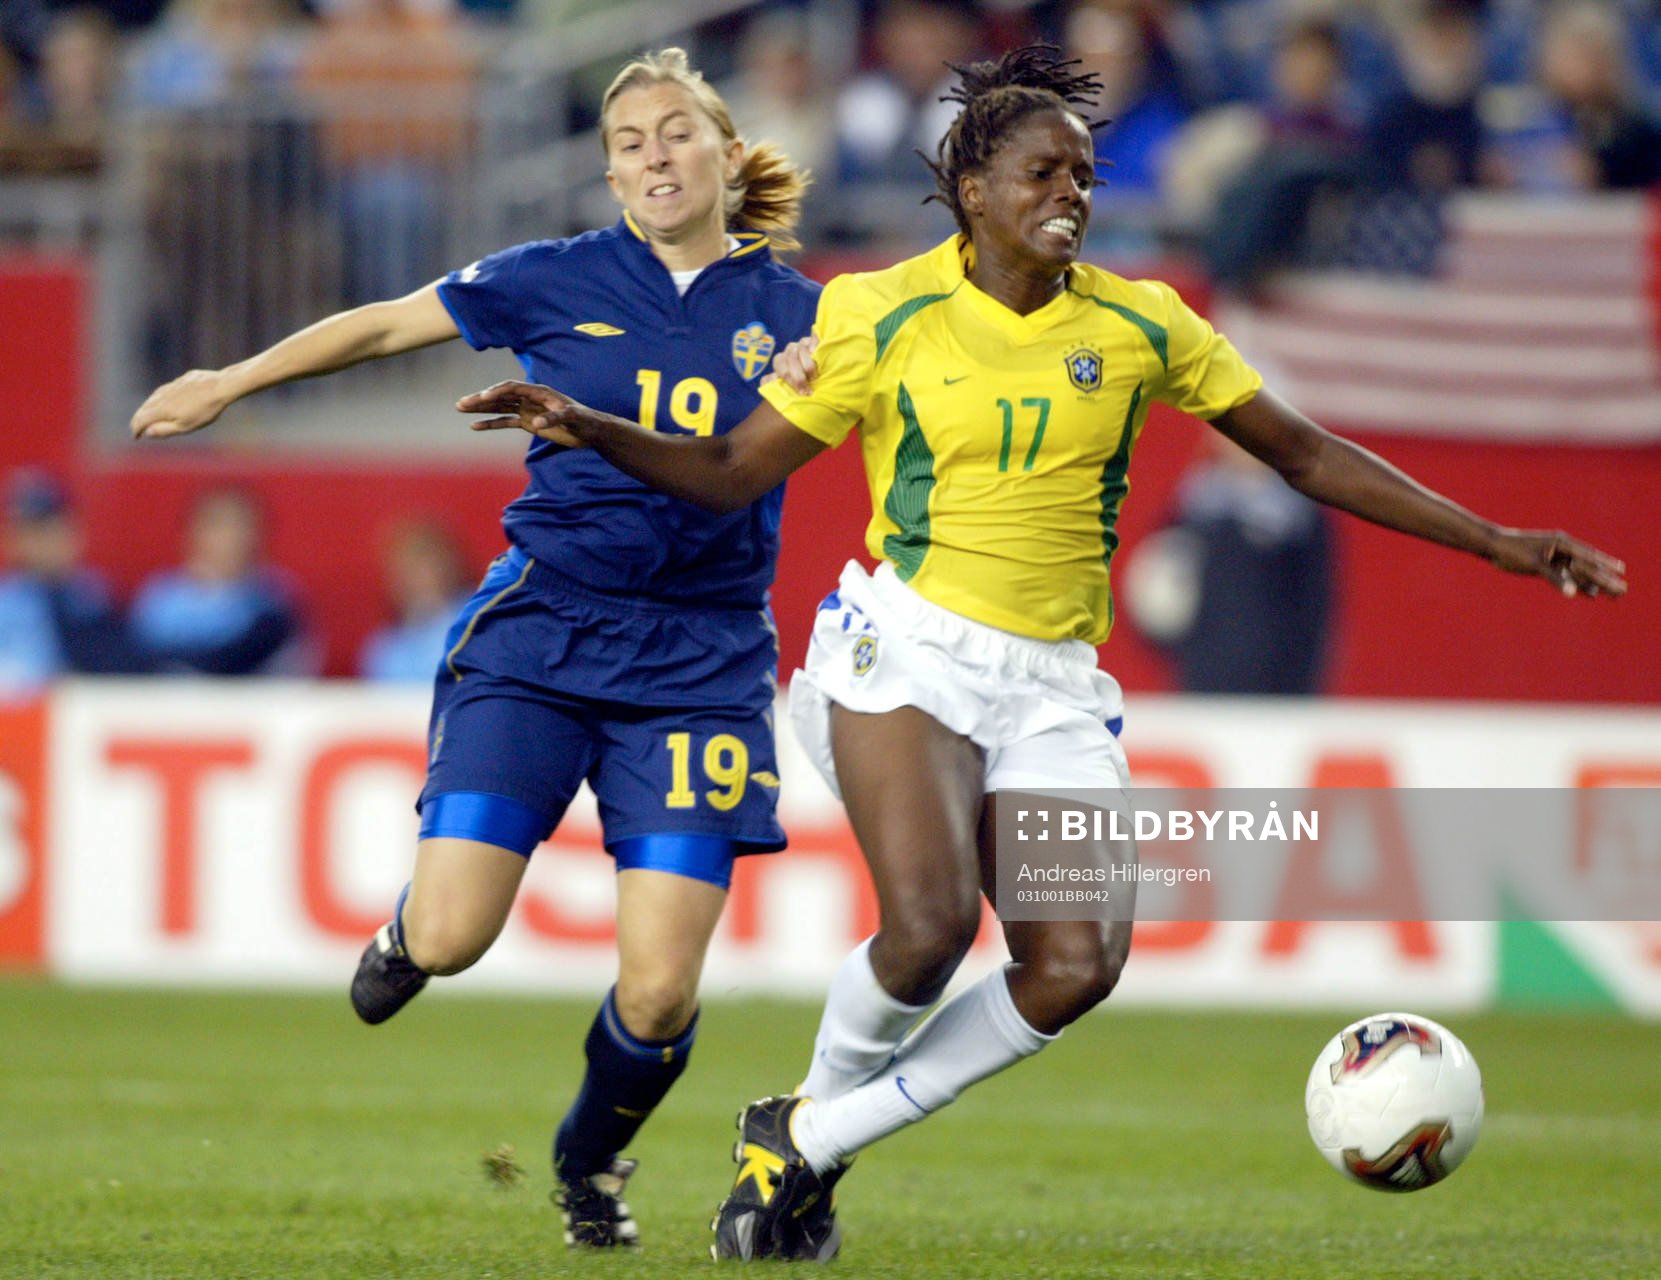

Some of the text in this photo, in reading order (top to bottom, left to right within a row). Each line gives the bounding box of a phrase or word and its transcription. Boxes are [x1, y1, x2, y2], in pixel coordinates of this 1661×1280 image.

[636, 368, 719, 437] 19
[996, 396, 1051, 473] 17
[665, 732, 749, 812] 19
[105, 737, 1443, 974] TOHBA
